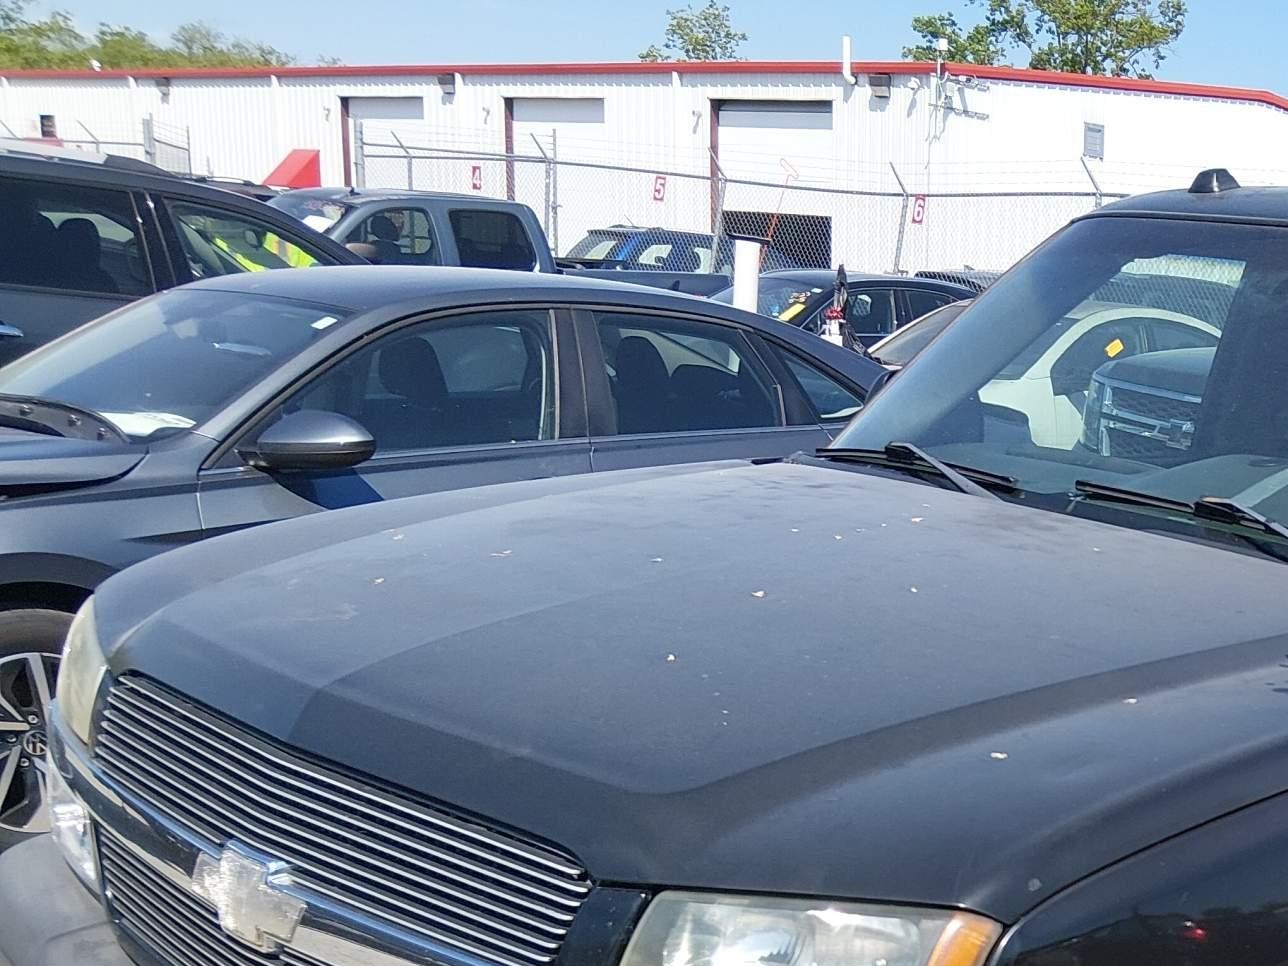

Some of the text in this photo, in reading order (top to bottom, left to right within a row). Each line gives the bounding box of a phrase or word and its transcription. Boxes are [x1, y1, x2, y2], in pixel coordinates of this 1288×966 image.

[472, 168, 481, 188] 4
[655, 178, 665, 199] 5
[913, 199, 925, 221] 6
